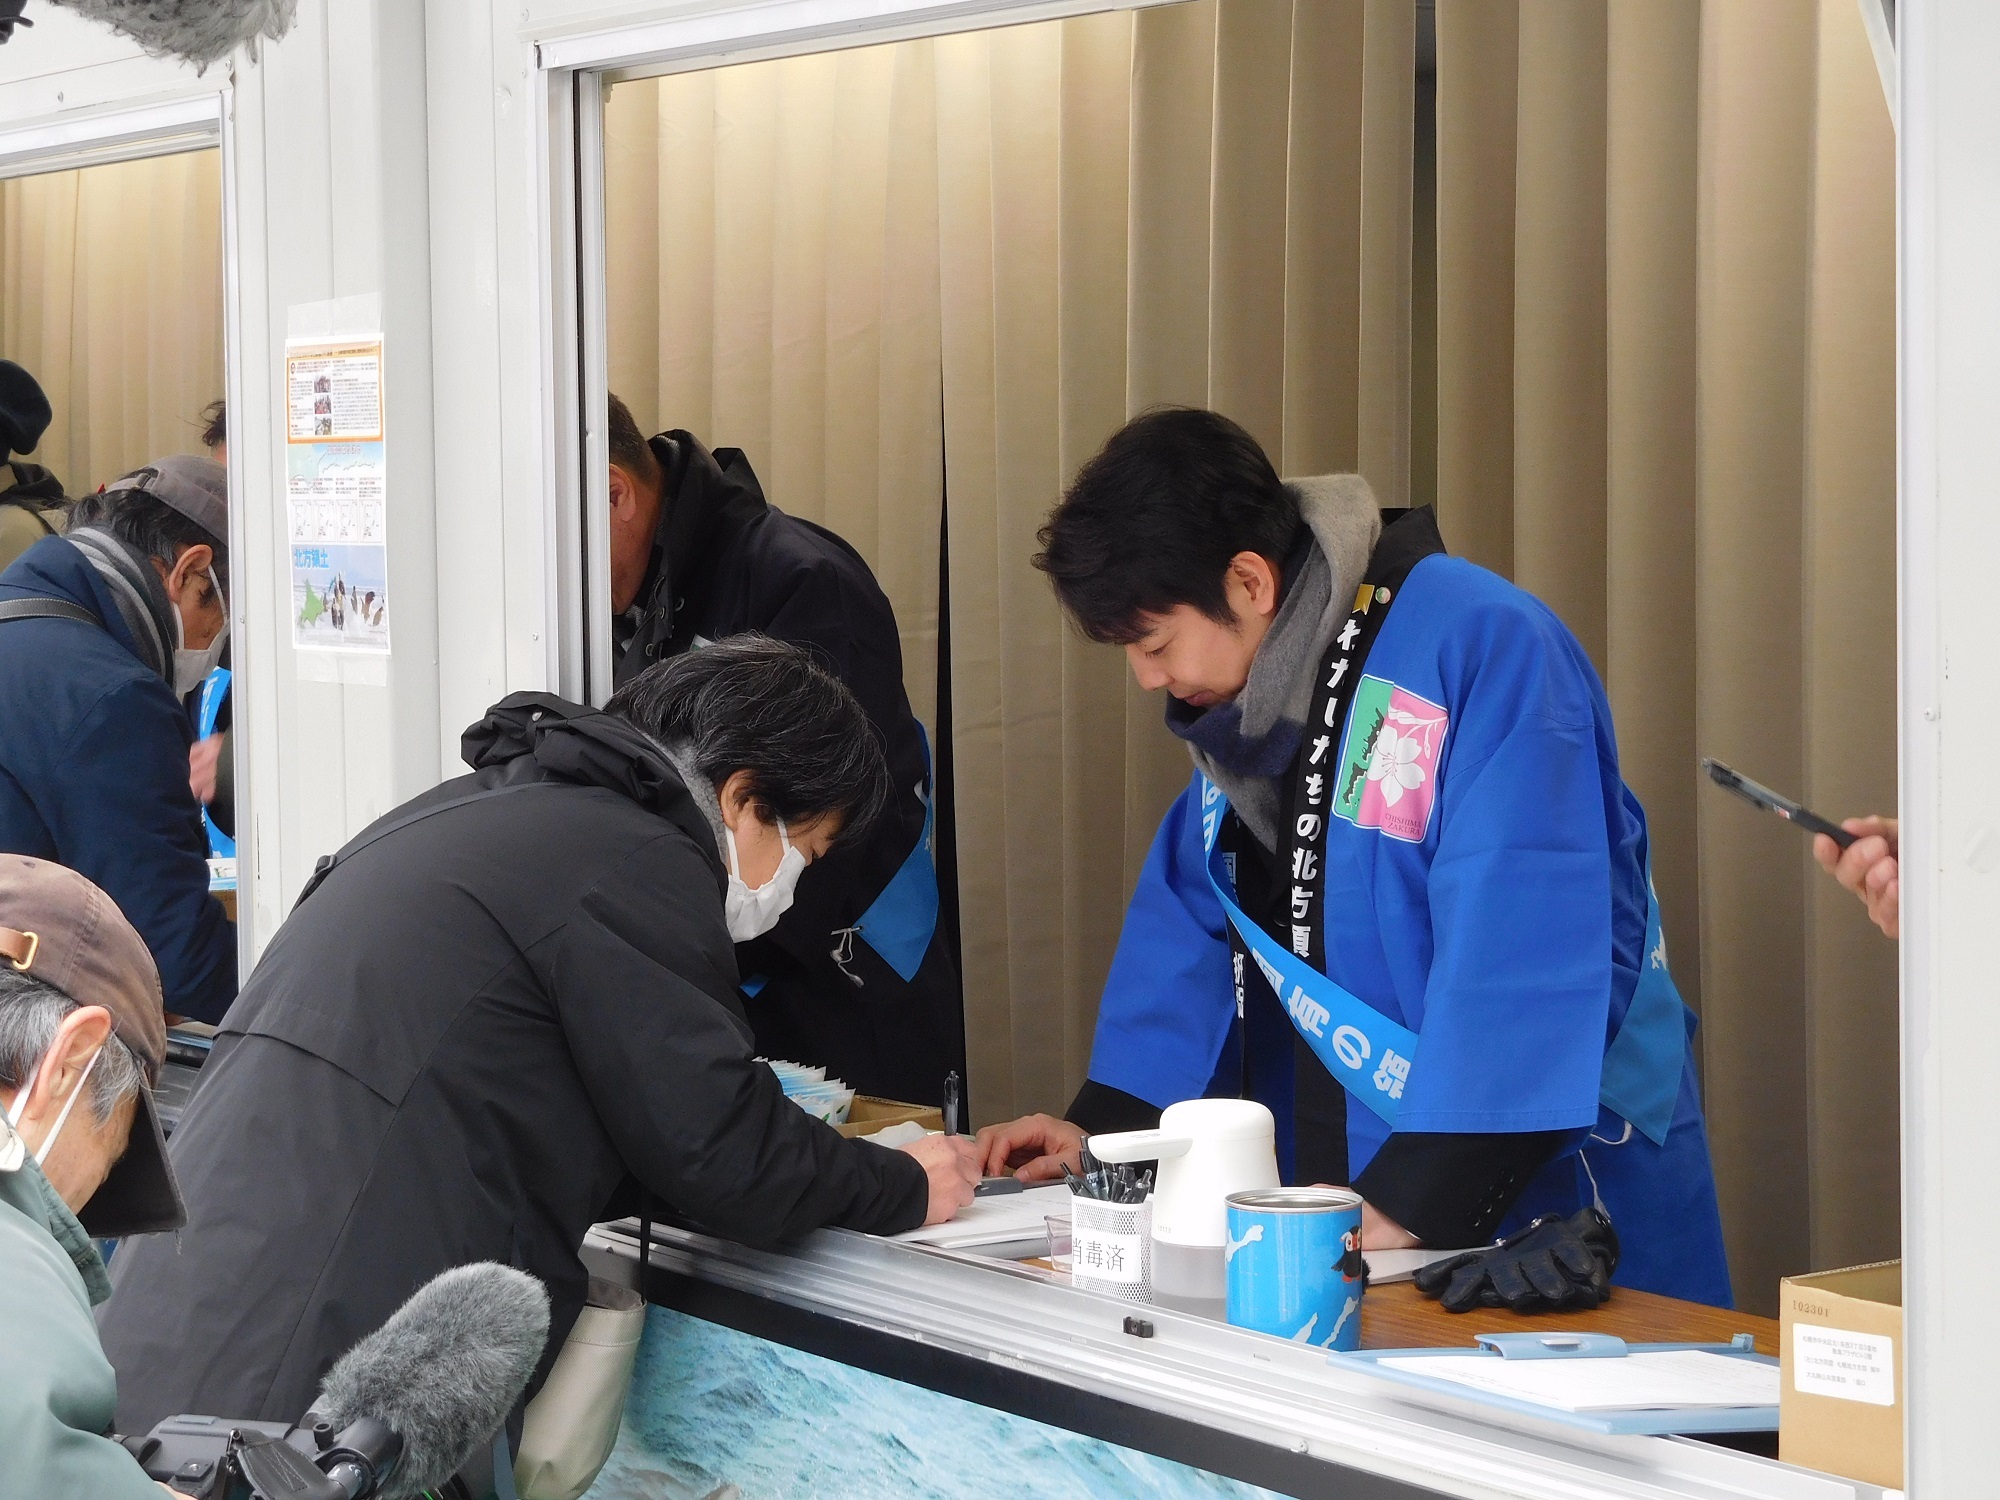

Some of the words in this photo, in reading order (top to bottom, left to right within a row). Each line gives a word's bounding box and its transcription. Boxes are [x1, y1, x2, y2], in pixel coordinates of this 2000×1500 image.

[295, 548, 329, 568] 北方領土
[1385, 812, 1421, 828] CHISHIMA
[1388, 822, 1420, 836] ZAKURA
[1792, 1299, 1829, 1318] 102301
